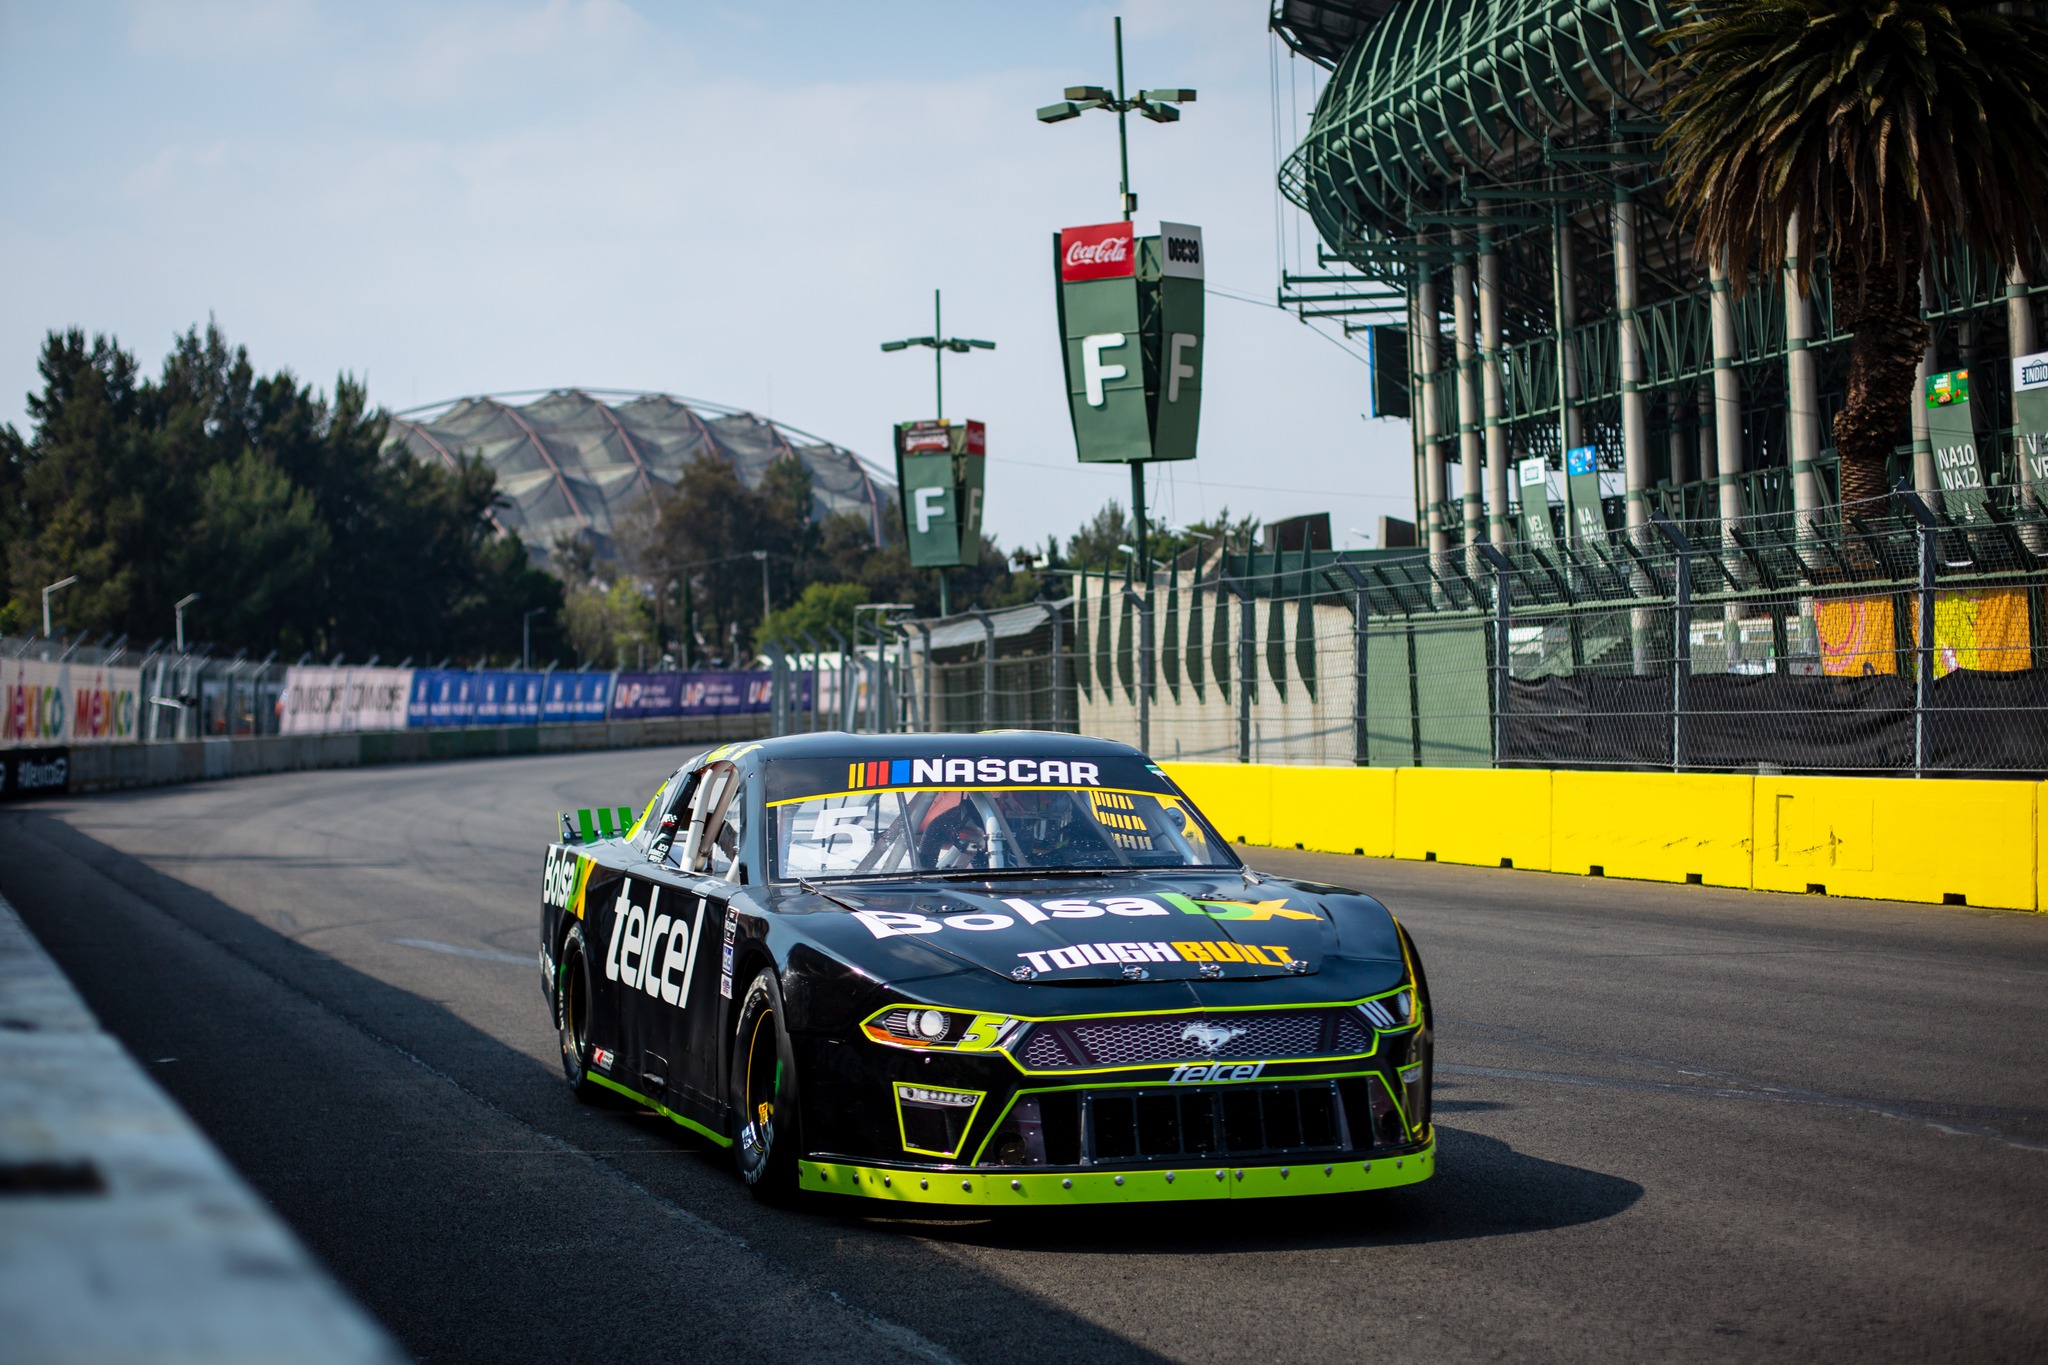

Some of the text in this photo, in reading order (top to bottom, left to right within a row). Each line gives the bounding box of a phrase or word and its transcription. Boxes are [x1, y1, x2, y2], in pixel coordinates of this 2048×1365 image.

[1082, 332, 1126, 407] F
[1168, 333, 1197, 402] F
[1938, 443, 1975, 469] NA10
[1942, 466, 1981, 490] NA12
[915, 487, 945, 533] F
[968, 487, 982, 531] F
[911, 758, 1100, 786] NASCAR
[811, 806, 873, 869] 5
[604, 876, 707, 1010] telcel
[955, 1013, 1011, 1051] 5
[1168, 1060, 1267, 1086] telcel
